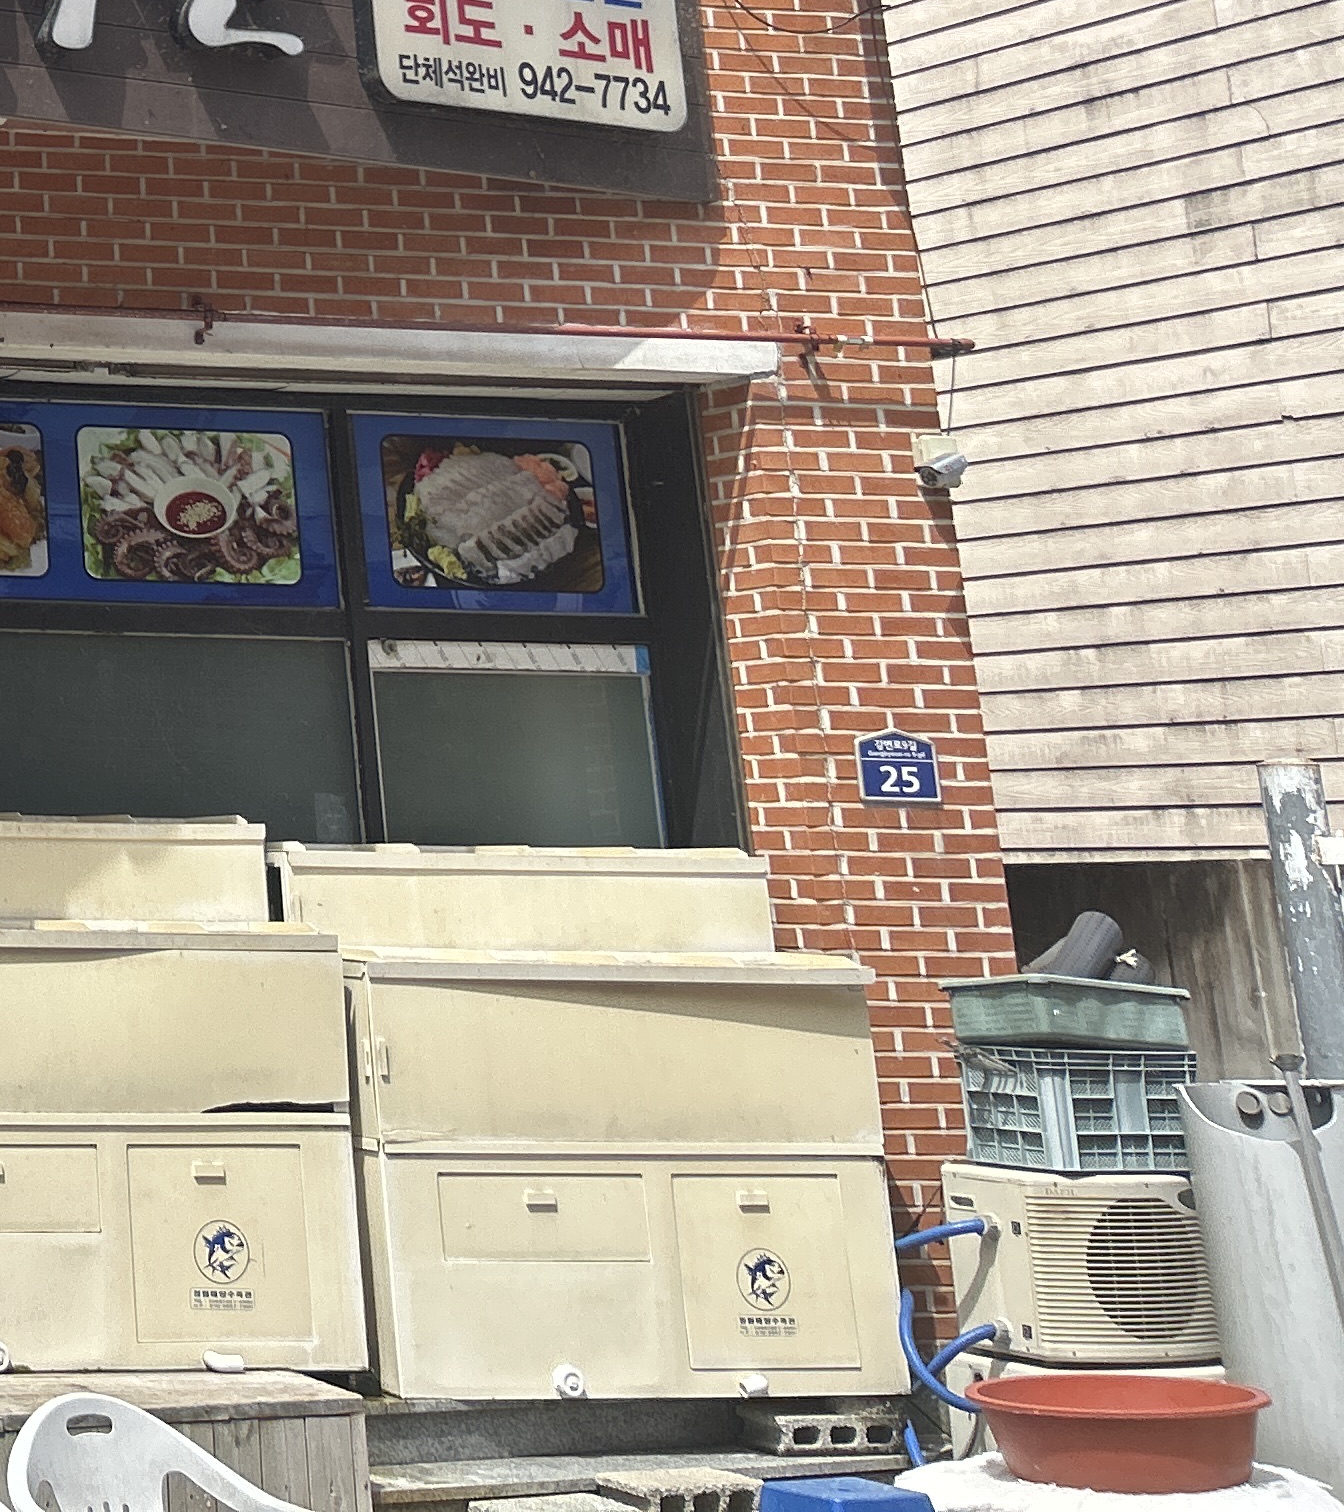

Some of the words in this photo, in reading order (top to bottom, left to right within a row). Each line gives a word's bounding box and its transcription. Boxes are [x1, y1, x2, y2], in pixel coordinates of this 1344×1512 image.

[558, 11, 654, 74] 소매
[398, 54, 508, 98] 단체석완비
[518, 61, 671, 116] 942-7734
[879, 765, 921, 793] 25
